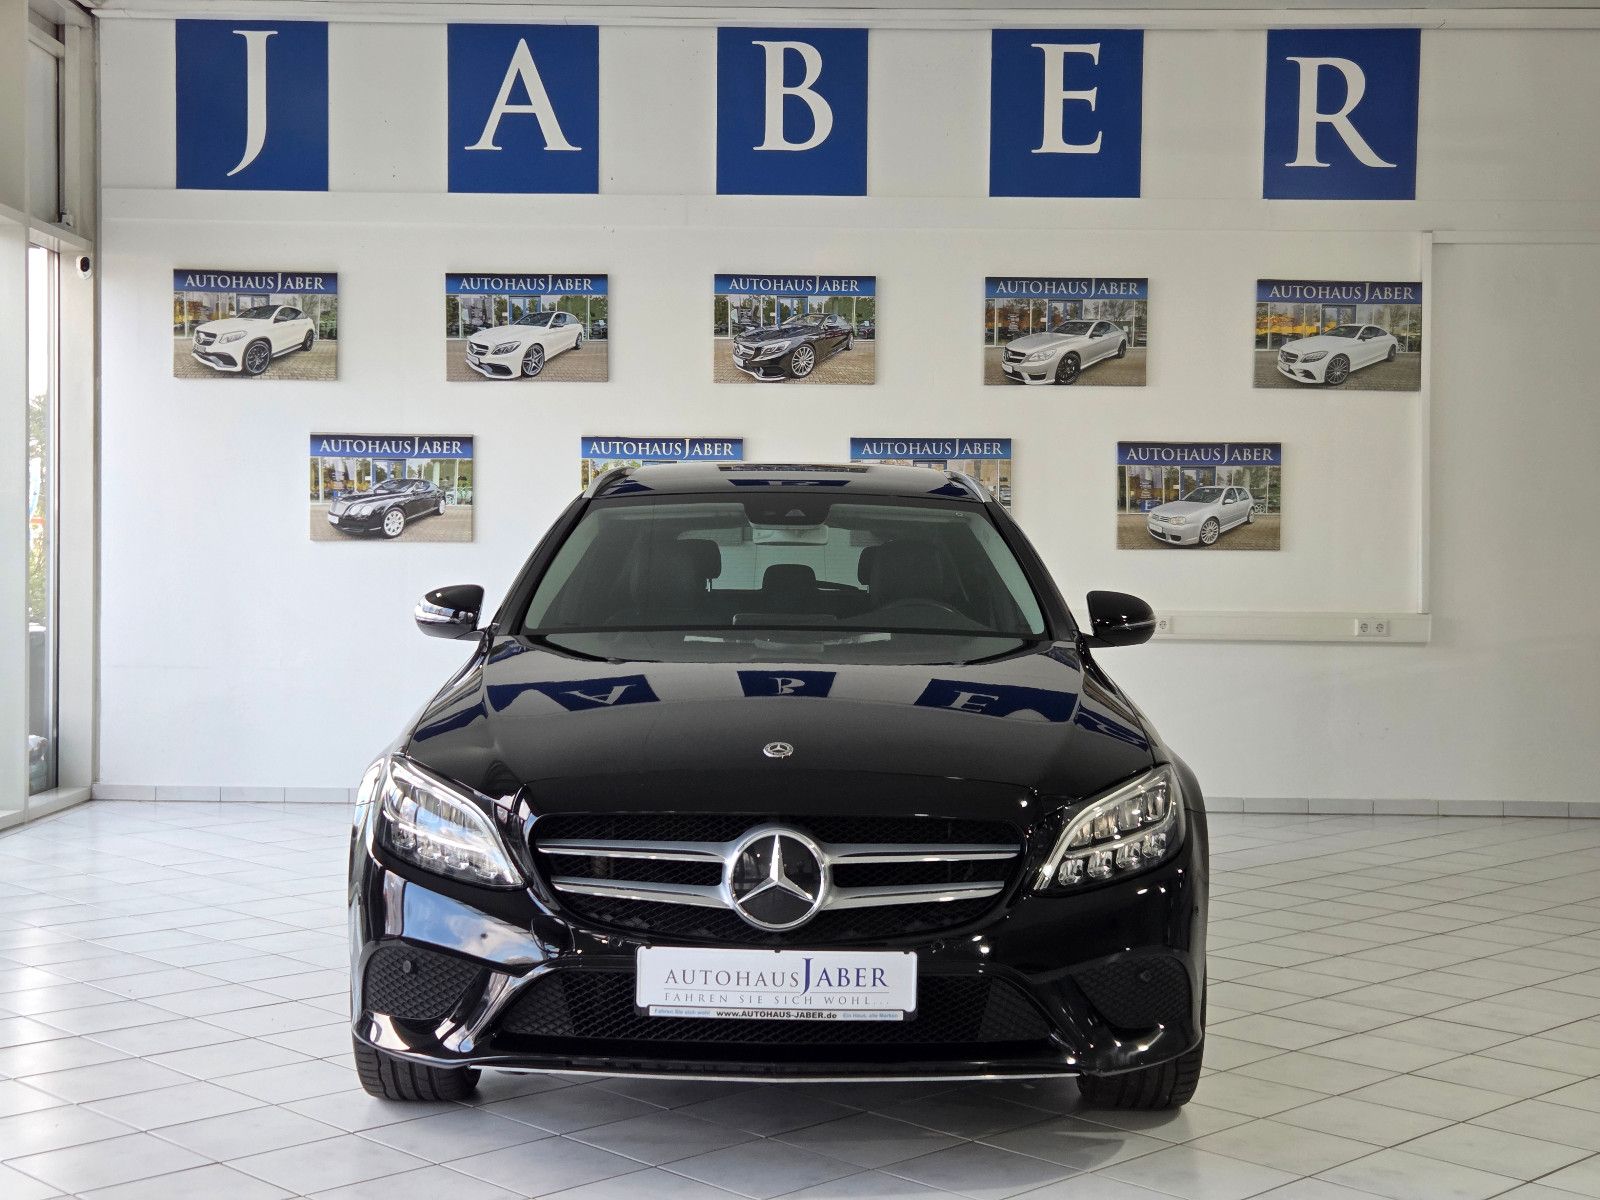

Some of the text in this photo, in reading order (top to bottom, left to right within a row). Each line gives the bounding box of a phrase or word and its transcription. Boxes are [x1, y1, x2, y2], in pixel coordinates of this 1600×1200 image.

[227, 30, 1397, 176] J A B E R
[664, 993, 728, 1003] FAHREN
[739, 995, 763, 1004] SIE
[774, 995, 812, 1004] SICH
[716, 1010, 837, 1019] www.AUTOHAUS-JABER.de
